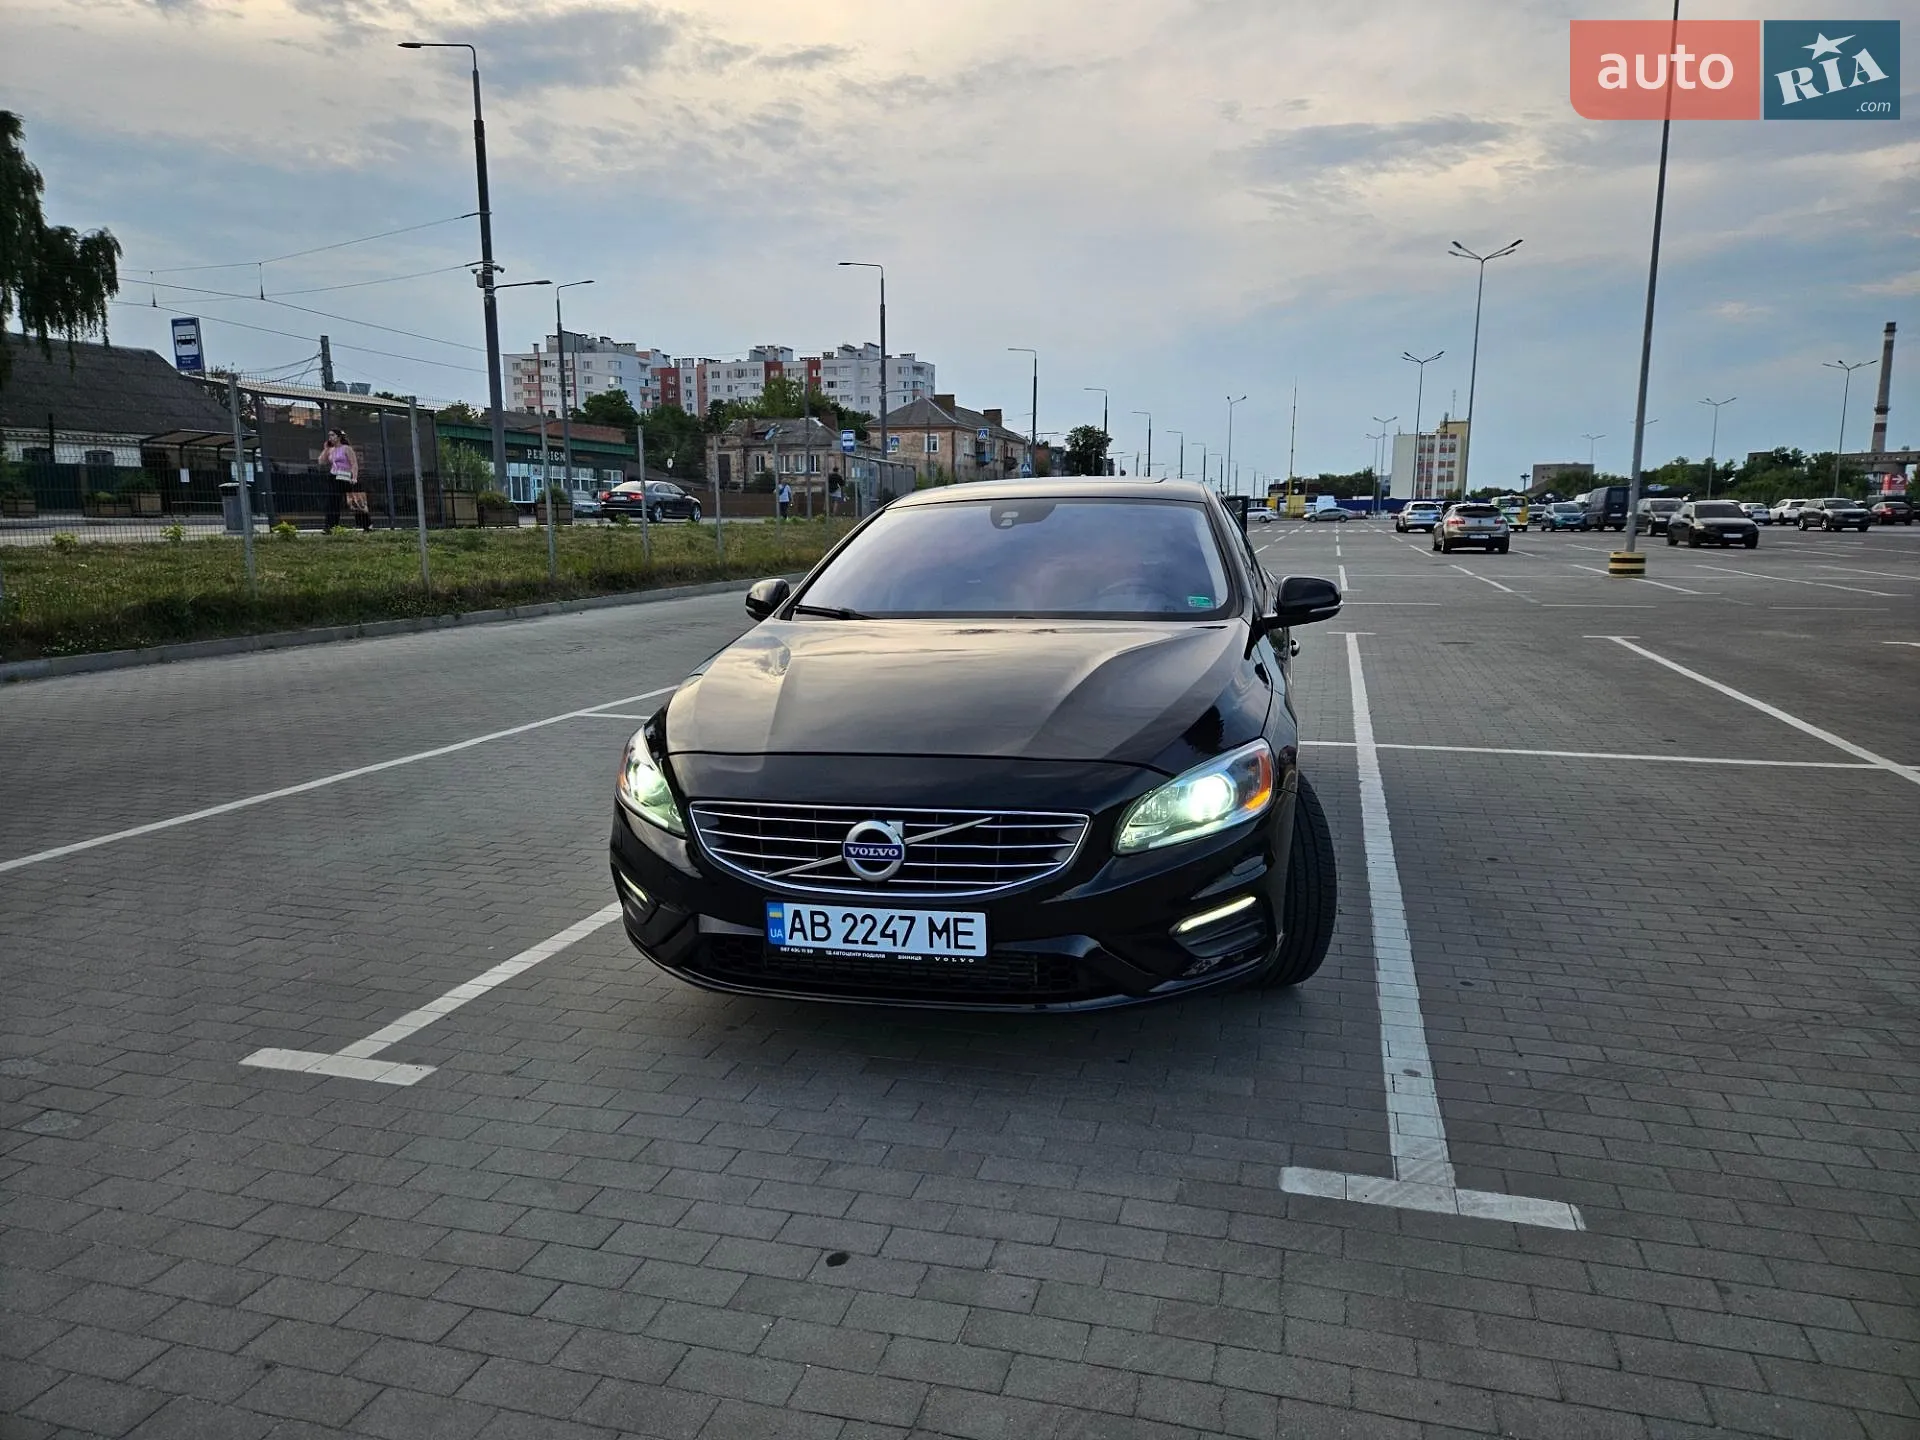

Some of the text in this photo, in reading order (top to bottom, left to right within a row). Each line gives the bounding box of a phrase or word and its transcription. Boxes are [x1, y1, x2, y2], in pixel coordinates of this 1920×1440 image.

[847, 846, 899, 857] VOLVO
[770, 928, 784, 939] UA
[788, 909, 976, 950] AB 2247 ME
